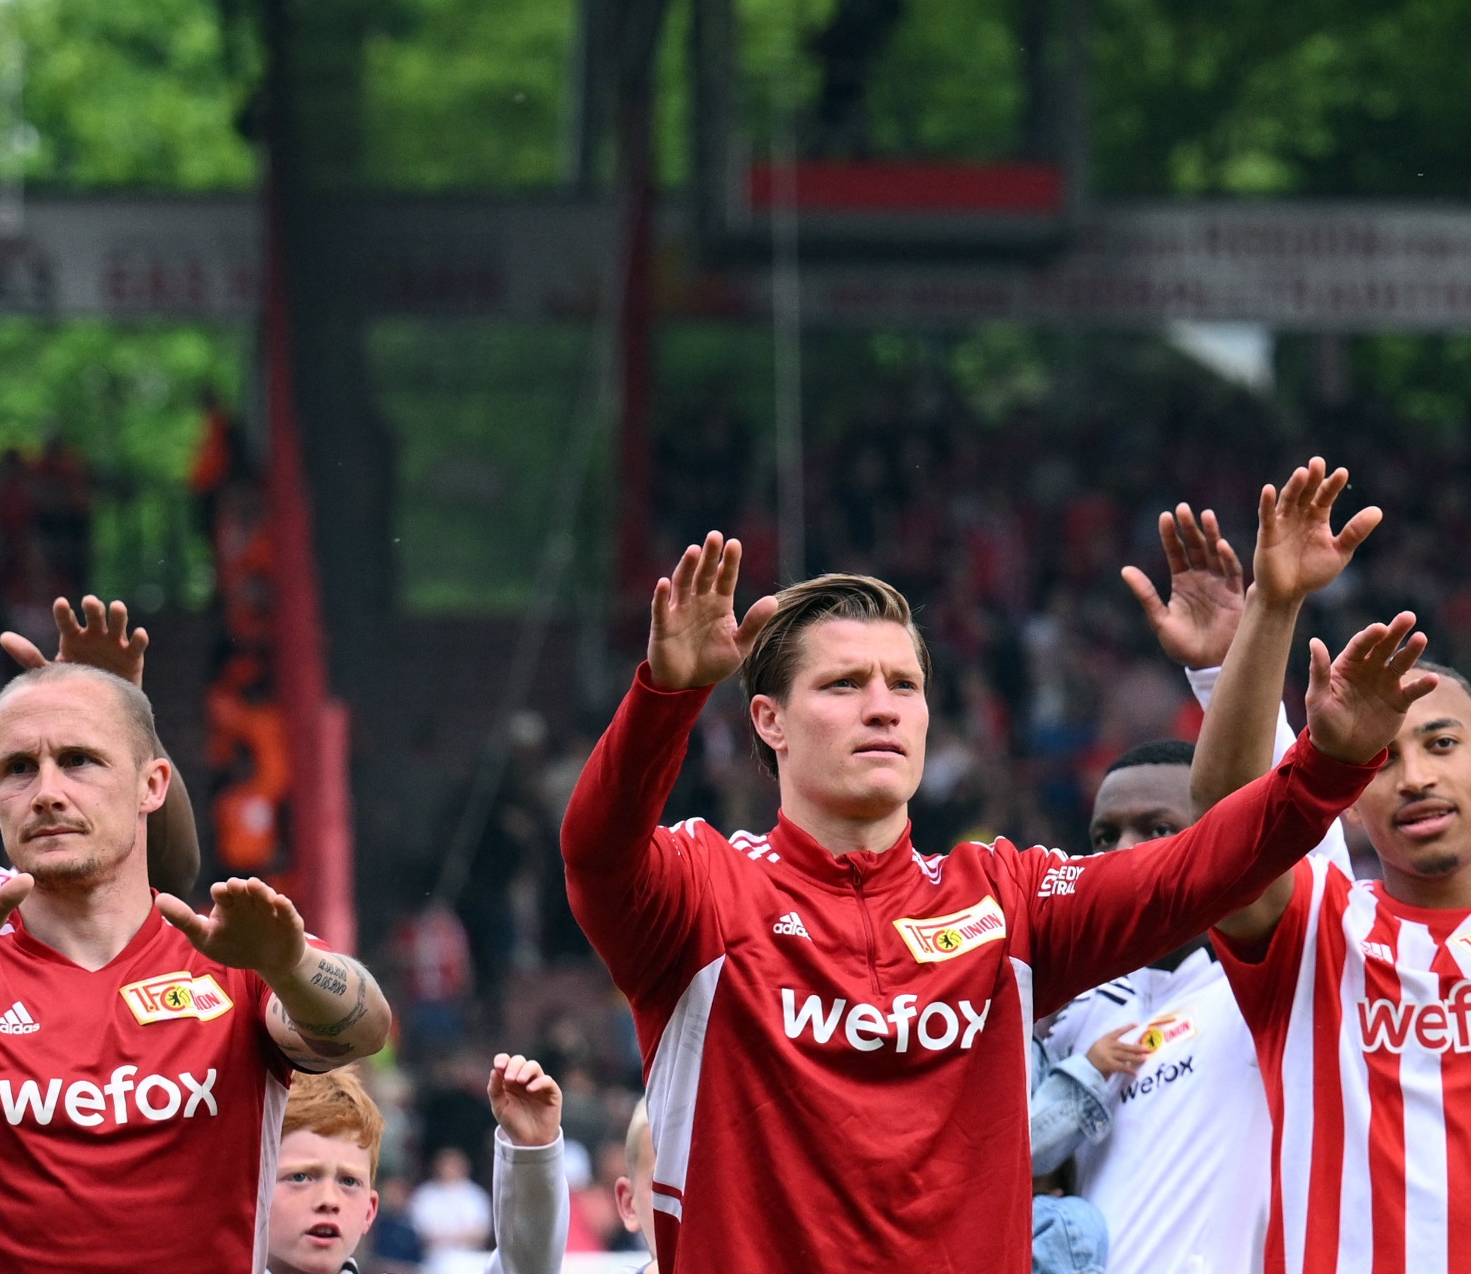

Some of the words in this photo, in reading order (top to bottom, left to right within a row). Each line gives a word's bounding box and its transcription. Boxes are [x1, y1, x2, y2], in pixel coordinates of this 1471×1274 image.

[961, 912, 1002, 941] UNION
[782, 988, 991, 1052] wefox
[1118, 1055, 1193, 1104] wefox
